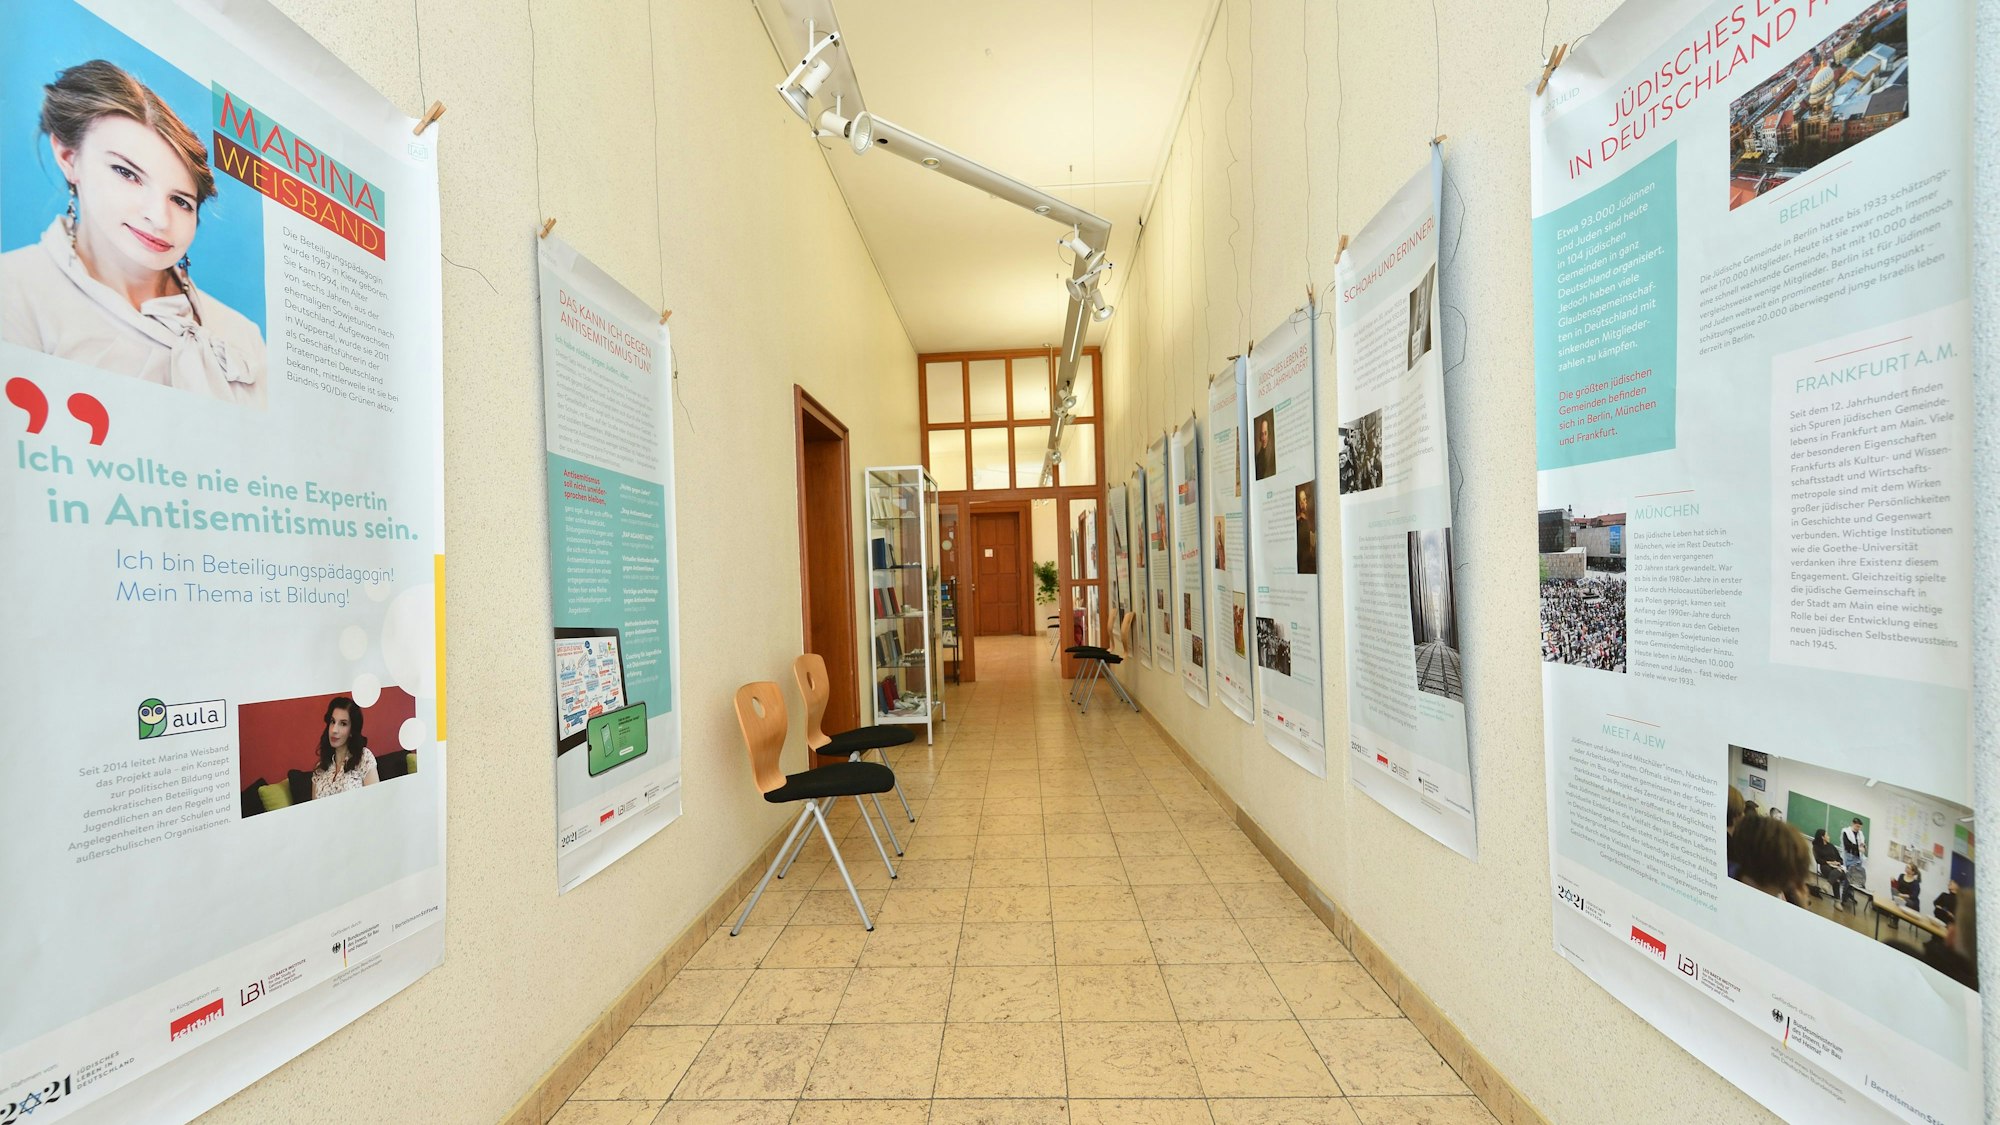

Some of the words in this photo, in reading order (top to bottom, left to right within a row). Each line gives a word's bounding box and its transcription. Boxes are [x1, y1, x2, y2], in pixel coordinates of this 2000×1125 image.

[1608, 4, 1746, 127] JÜDISCHES
[1569, 148, 1593, 180] IN
[1601, 7, 1797, 162] DEUTSCHLAND
[220, 92, 379, 221] MARINA
[218, 137, 378, 251] WEISBAND
[1557, 224, 1579, 241] Etwa
[1581, 204, 1615, 229] 93.000
[1617, 181, 1655, 211] Jüdinnen
[1779, 183, 1839, 225] BERLIN
[283, 226, 298, 241] Die
[1557, 240, 1574, 255] und
[1575, 228, 1602, 247] Juden
[1604, 218, 1622, 233] sind
[1623, 203, 1648, 222] heute
[1557, 259, 1565, 270] in
[1568, 251, 1583, 265] 104
[1585, 231, 1626, 260] jüdischen
[1557, 256, 1608, 283] Gemeinden
[1609, 251, 1617, 261] in
[1619, 241, 1640, 259] ganz
[283, 243, 309, 261] wurde
[312, 255, 330, 271] 1987
[332, 265, 339, 275] in
[359, 280, 390, 301] geboren,
[283, 255, 296, 269] Sie
[299, 262, 316, 278] kam
[318, 271, 339, 290] 1994,
[340, 282, 349, 293] im
[1343, 268, 1377, 303] SCHOAH
[1378, 253, 1396, 277] UND
[1558, 269, 1611, 299] Deutschland
[1612, 245, 1665, 274] organisiert.
[284, 272, 300, 284] von
[302, 280, 325, 296] sechs
[327, 289, 353, 310] Jahren,
[354, 304, 366, 315] aus
[367, 309, 379, 321] der
[1557, 281, 1657, 328] Glaubensgemeinschaf-
[1558, 295, 1588, 314] Jedoch
[1589, 284, 1616, 300] haben
[1617, 273, 1640, 289] viele
[284, 286, 331, 312] ehemaligen
[378, 328, 395, 340] nach
[559, 289, 578, 314] DAS
[579, 304, 606, 332] KANN
[607, 322, 623, 342] ICH
[624, 333, 652, 359] GEGEN
[1558, 331, 1573, 343] ten
[1574, 328, 1582, 337] in
[1585, 305, 1639, 334] Deutschland
[1640, 299, 1656, 313] mit
[560, 311, 633, 364] ANTISEMITISMUS
[1558, 336, 1600, 357] sinkenden
[1602, 319, 1651, 342] Mitglieder-
[1558, 355, 1585, 372] zahlen
[1587, 353, 1597, 363] zu
[1796, 353, 1911, 393] FRANKFURT
[1914, 349, 1933, 367] A.
[1936, 342, 1958, 362] M.
[1558, 397, 1607, 415] Gemeinden
[1608, 386, 1647, 404] befinden
[1559, 391, 1574, 401] Die
[1575, 381, 1609, 399] größten
[1610, 368, 1652, 390] jüdischen
[1790, 408, 1807, 420] Seit
[1808, 406, 1829, 416] dem
[1831, 401, 1843, 412] 12.
[1846, 388, 1909, 409] Jahrhundert
[1911, 383, 1944, 396] finden
[1559, 419, 1576, 431] sich
[1577, 417, 1585, 426] in
[1587, 411, 1613, 424] Berlin,
[1615, 400, 1657, 417] München
[1789, 420, 1807, 433] sich
[1808, 417, 1841, 431] Spuren
[1843, 406, 1892, 425] jüdischen
[1894, 396, 1950, 413] Gemeinde-
[1559, 435, 1575, 446] und
[1577, 426, 1618, 442] Frankfurt.
[17, 439, 74, 475] Ich
[86, 457, 188, 488] wollte
[197, 469, 239, 494] nie
[247, 475, 298, 500] eine
[305, 481, 387, 511] Expertin
[47, 487, 89, 524] in
[104, 493, 358, 538] Antisemitismus
[364, 516, 419, 541] sein.
[1634, 503, 1700, 520] MÜNCHEN
[117, 548, 153, 570] Ich
[162, 551, 195, 572] bin
[203, 554, 394, 585] Beteiligungspädagogin!
[116, 580, 177, 602] Mein
[184, 582, 253, 603] Thema
[260, 586, 281, 603] ist
[287, 586, 350, 608] Bildung!
[172, 707, 219, 728] aula
[1601, 724, 1631, 740] MEET
[1632, 732, 1641, 744] A
[1642, 733, 1666, 750] JEW
[79, 766, 101, 777] Seit
[103, 760, 129, 773] 2014
[131, 756, 156, 768] leitet
[158, 752, 188, 763] Marina
[190, 744, 229, 757] Weisband
[96, 779, 113, 788] das
[116, 771, 151, 784] Projekt
[153, 767, 172, 777] aula
[181, 763, 194, 772] ein
[197, 756, 230, 769] Konzept
[83, 796, 163, 819] demokratischen
[165, 786, 214, 801] Beteiligung
[216, 782, 230, 790] von
[110, 790, 126, 799] zur
[128, 779, 180, 798] politischen
[181, 773, 213, 785] Bildung
[215, 768, 230, 778] und
[67, 824, 155, 851] Angelegenheiten
[157, 819, 178, 829] ihrer
[180, 810, 214, 823] Schulen
[215, 804, 231, 815] und
[83, 812, 150, 833] Jugendlichen
[152, 809, 163, 817] an
[165, 805, 183, 814] den
[185, 797, 214, 809] Regeln
[215, 792, 231, 802] und
[76, 835, 162, 864] außerschulischen
[164, 818, 232, 840] Organisationen.
[1631, 935, 1666, 960] zeitbild
[1677, 953, 1699, 981] LBI
[240, 979, 266, 1007] LBI
[172, 1008, 223, 1040] zeitbild
[1792, 1027, 1802, 1037] des
[1792, 1019, 1844, 1053] Bundesministerium
[76, 1050, 120, 1076] JÜDISCHES
[1802, 1038, 1822, 1056] Heimat
[76, 1067, 102, 1083] LEBEN
[104, 1061, 113, 1069] IN
[76, 1057, 135, 1090] DEUTSCHLAND
